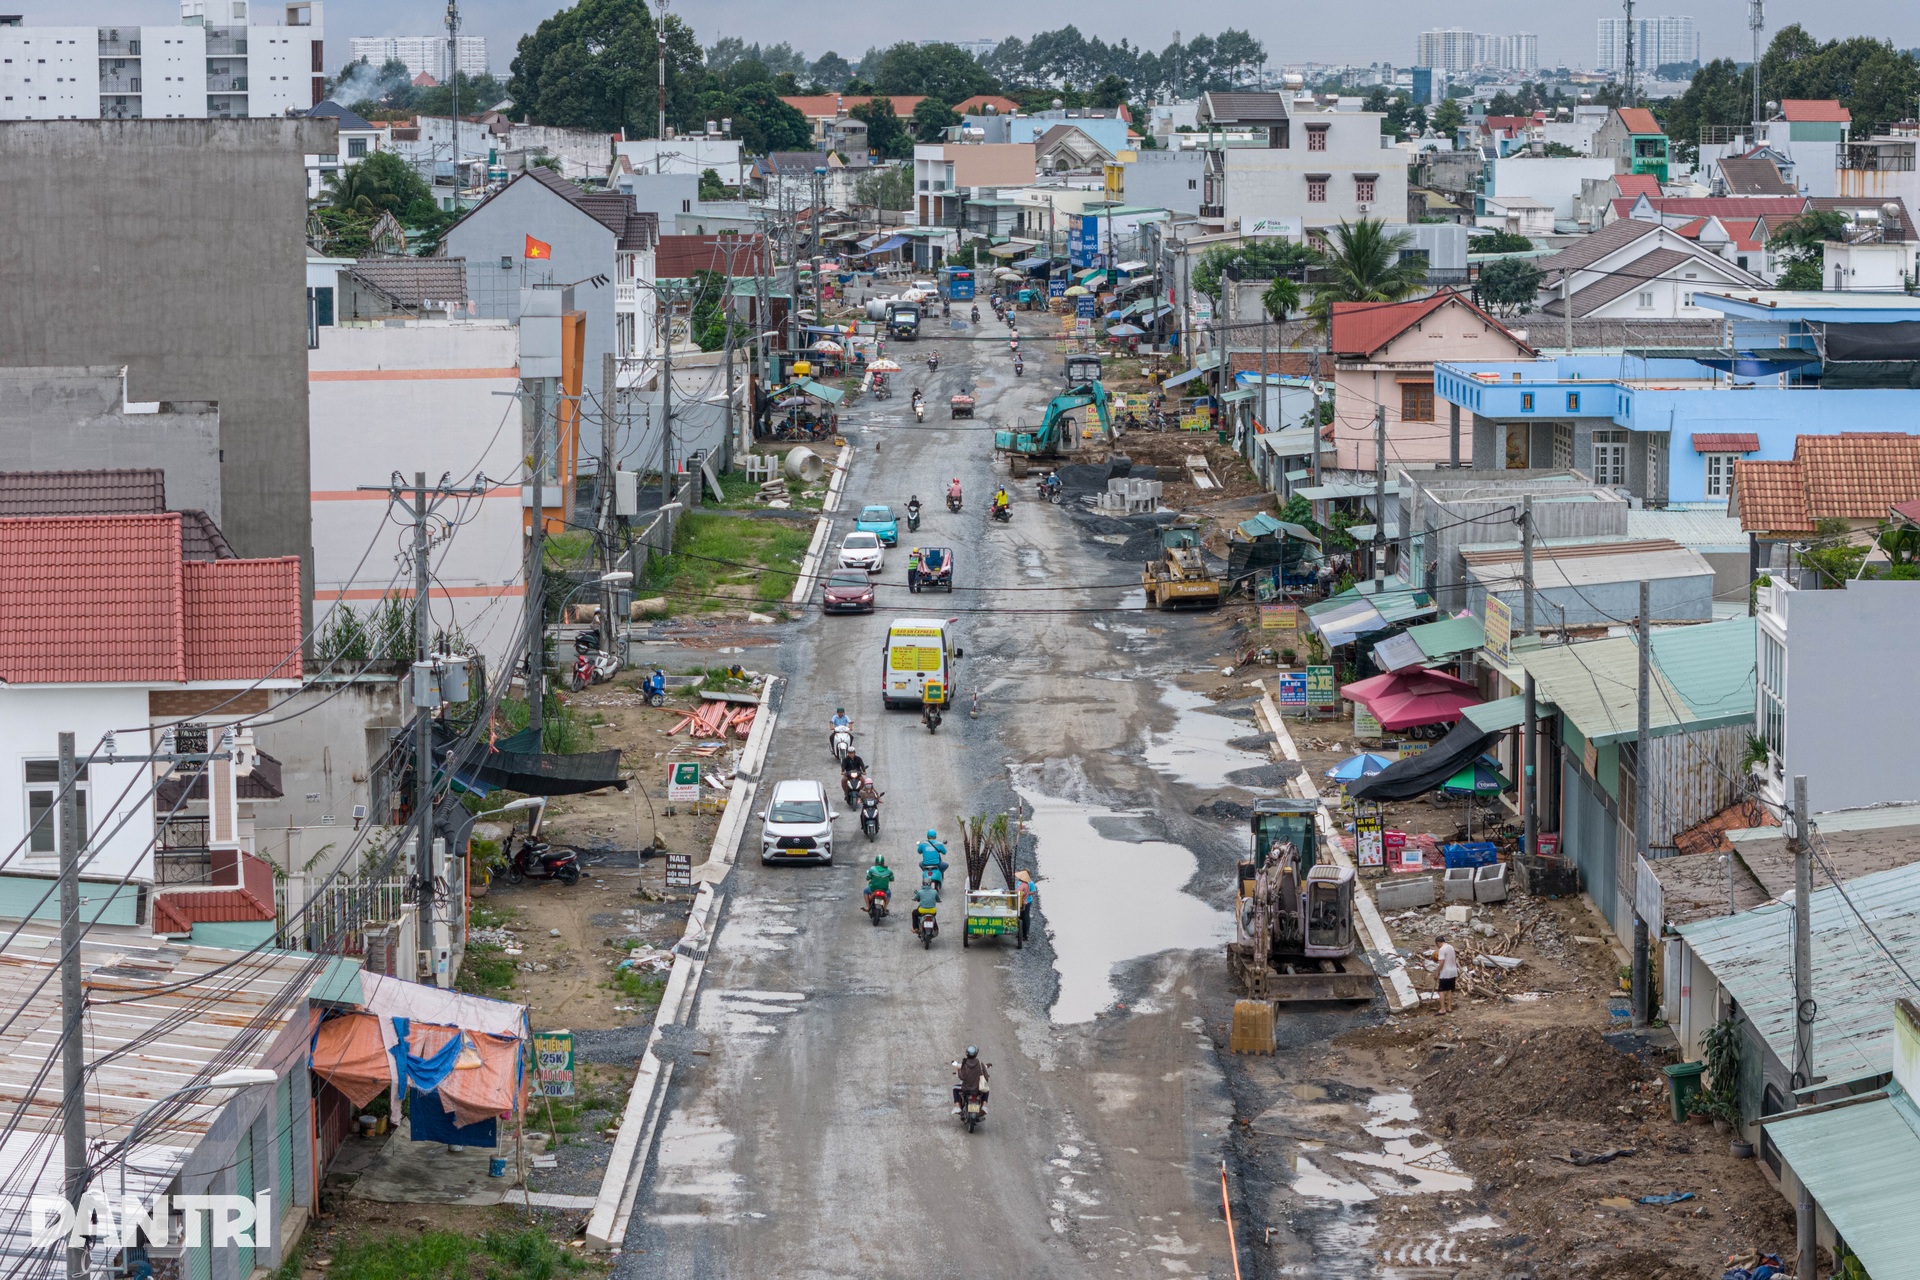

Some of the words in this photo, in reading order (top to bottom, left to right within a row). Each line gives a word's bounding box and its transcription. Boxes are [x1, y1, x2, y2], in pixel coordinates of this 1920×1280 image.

[1318, 675, 1333, 690] XE
[985, 927, 996, 935] CÂY
[545, 1036, 561, 1052] TIẾU
[562, 1037, 572, 1053] MÌ
[543, 1053, 563, 1064] 25K
[544, 1085, 563, 1095] 20K
